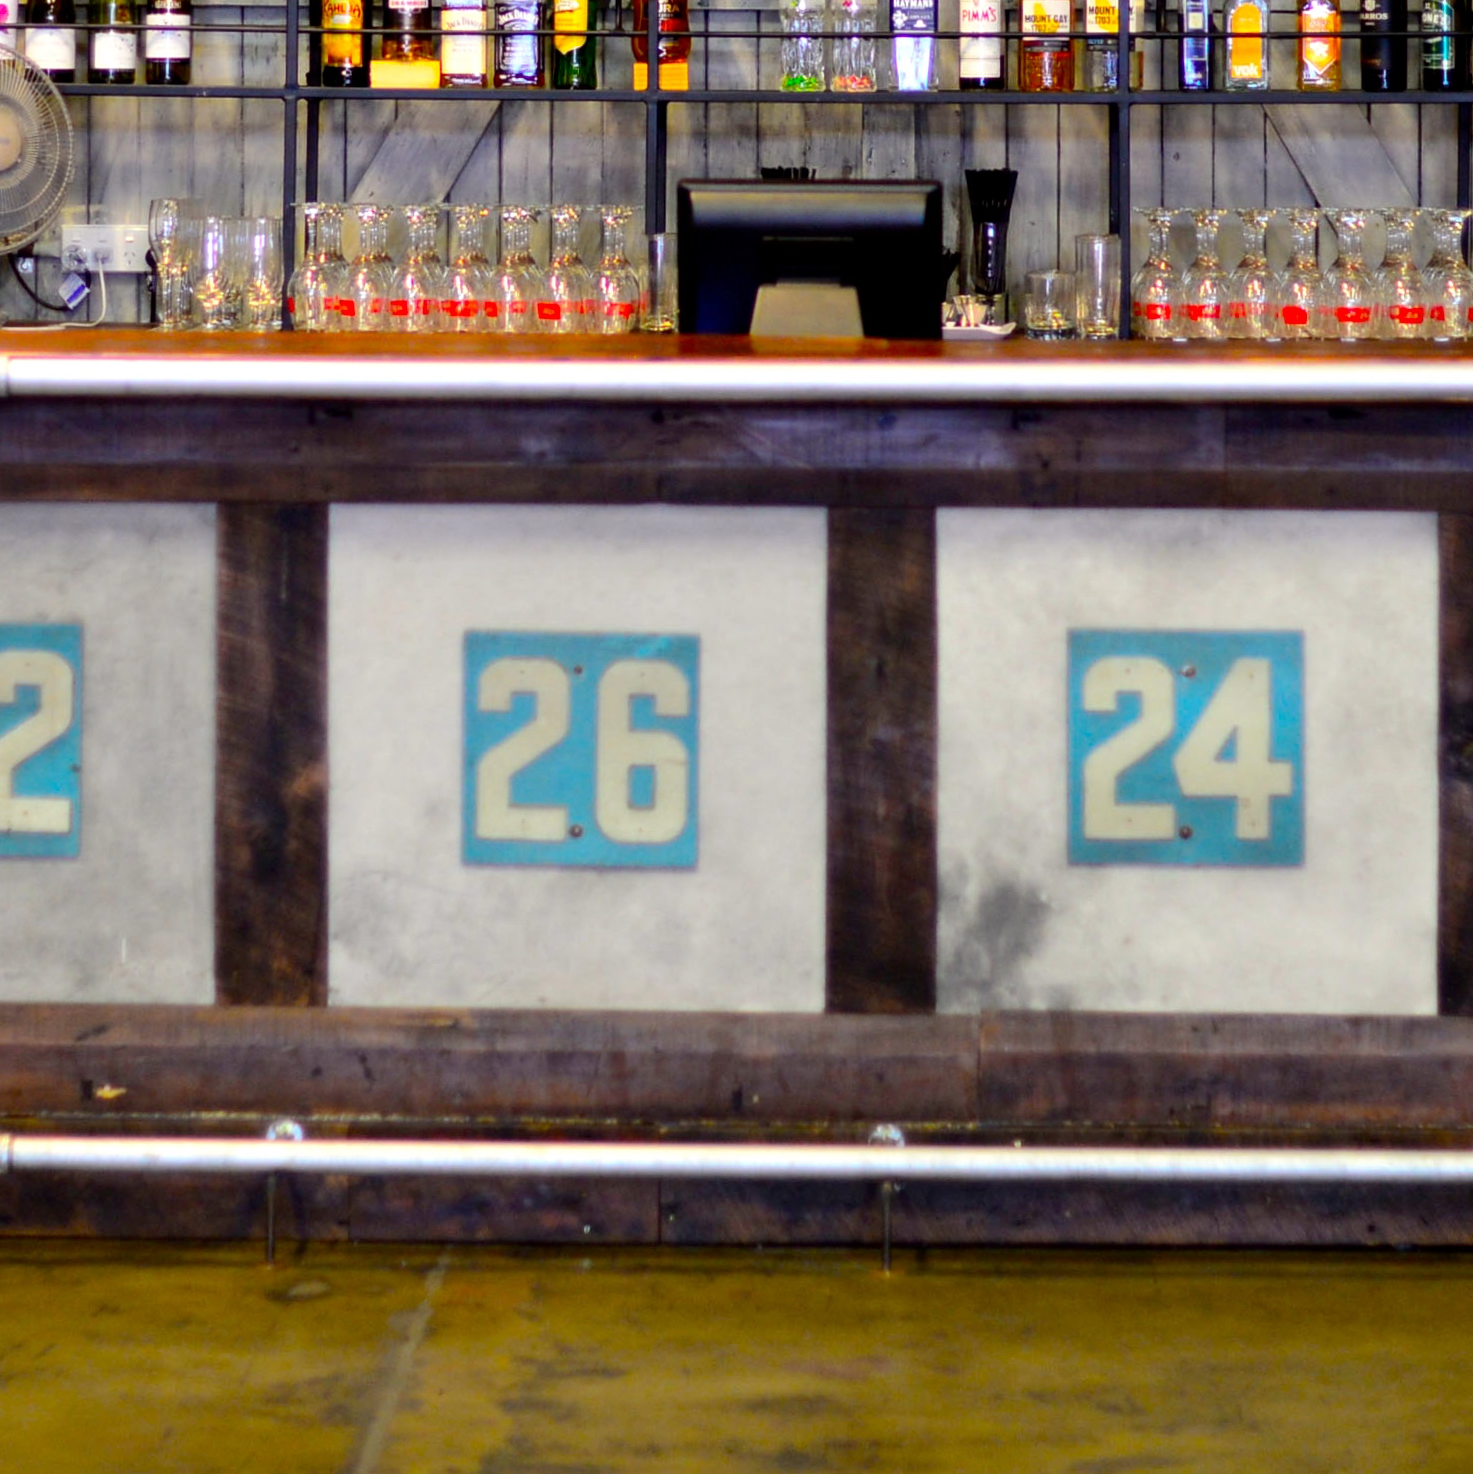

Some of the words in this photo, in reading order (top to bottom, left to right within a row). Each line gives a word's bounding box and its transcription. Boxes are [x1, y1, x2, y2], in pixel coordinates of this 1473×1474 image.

[962, 7, 997, 23] PIMM'S
[1088, 6, 1116, 15] MOUNT
[1025, 14, 1051, 24] MOUNT
[1053, 14, 1069, 24] GAY
[1234, 63, 1258, 77] vok
[472, 654, 691, 848] 26
[1080, 653, 1295, 846] 24
